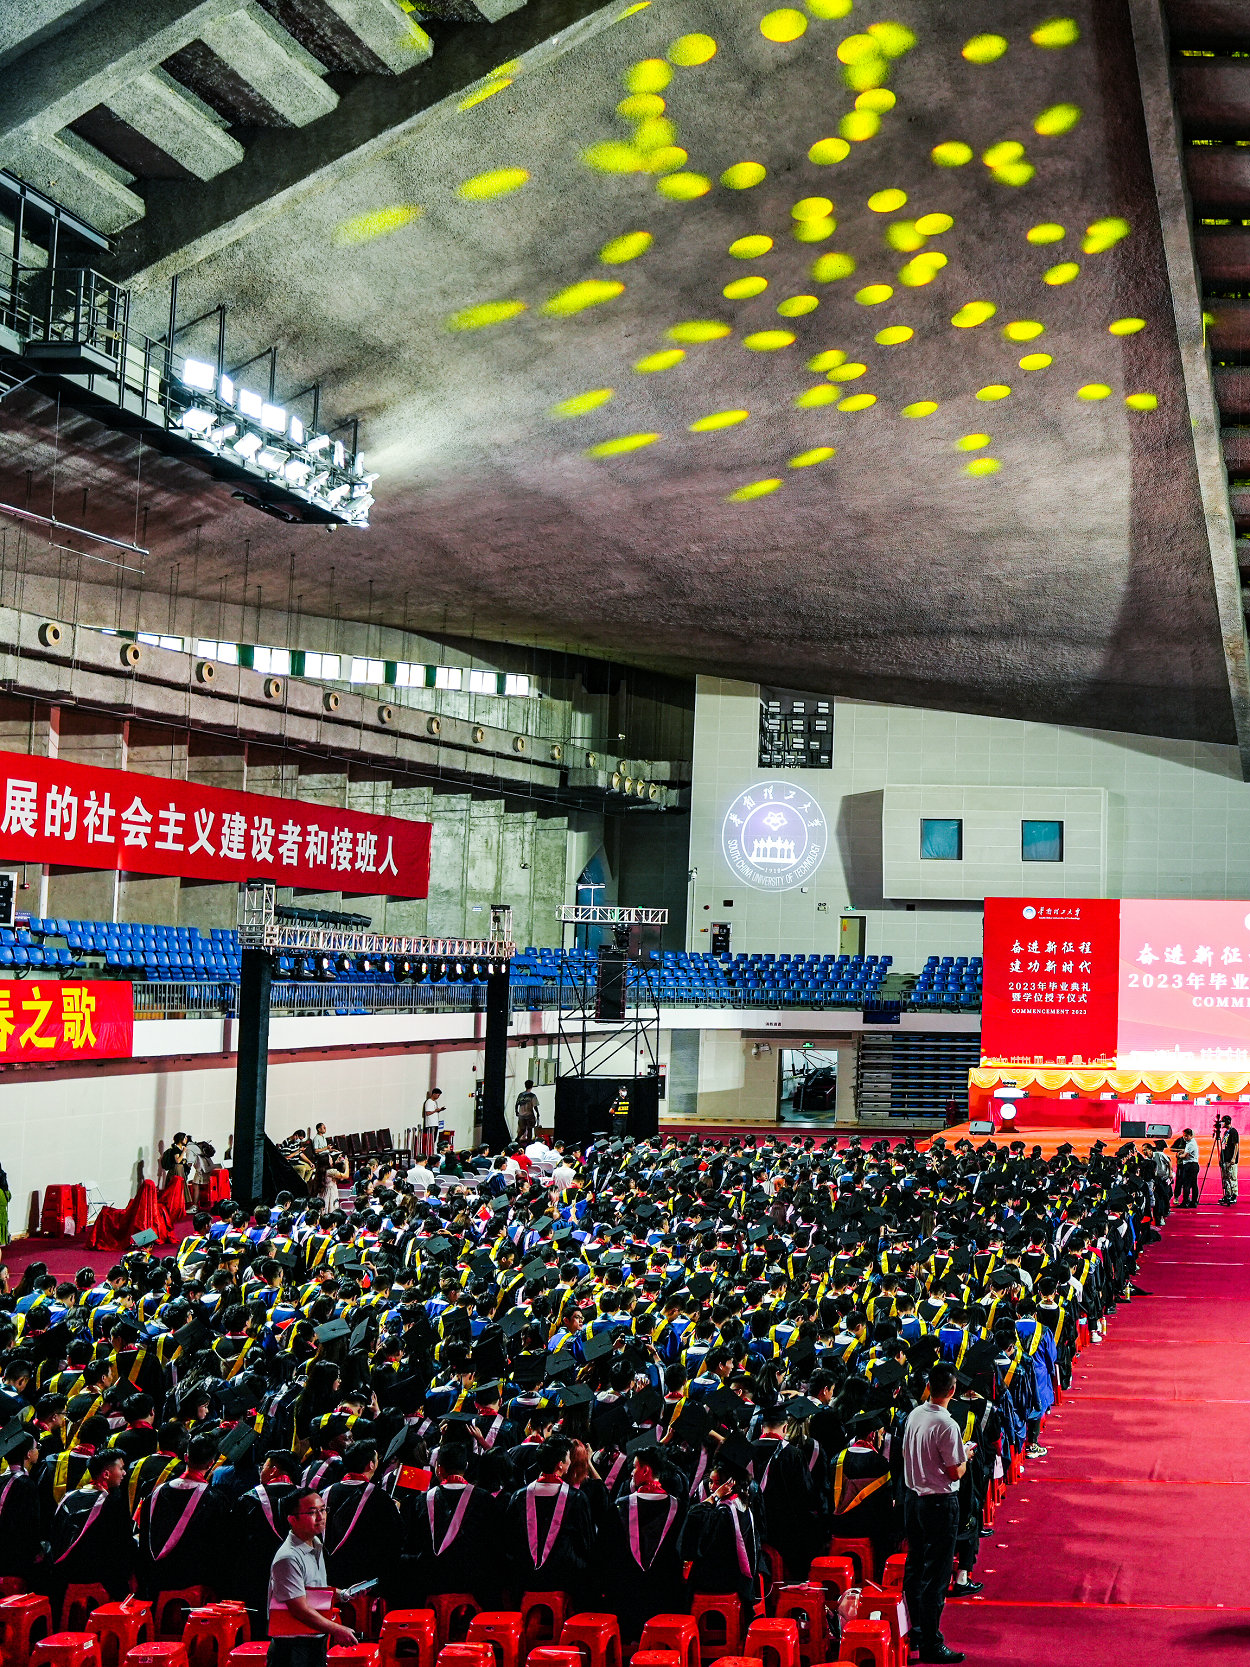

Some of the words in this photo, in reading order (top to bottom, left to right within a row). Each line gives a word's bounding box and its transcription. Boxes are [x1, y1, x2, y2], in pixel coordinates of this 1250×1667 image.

[1, 778, 399, 877] 展的社会主义建设者和接班人
[728, 839, 742, 861] SOUTH
[736, 859, 753, 879] CHINA
[752, 873, 784, 887] UNIVERSITY
[786, 873, 793, 883] OF
[793, 843, 821, 879] TECHNOLOGY
[1010, 939, 1092, 955] 奋进新征程
[1009, 959, 1091, 974] 建功新时代
[1008, 982, 1091, 992] 2023年毕业典礼
[1011, 993, 1088, 1003] 暨学位授予仪式
